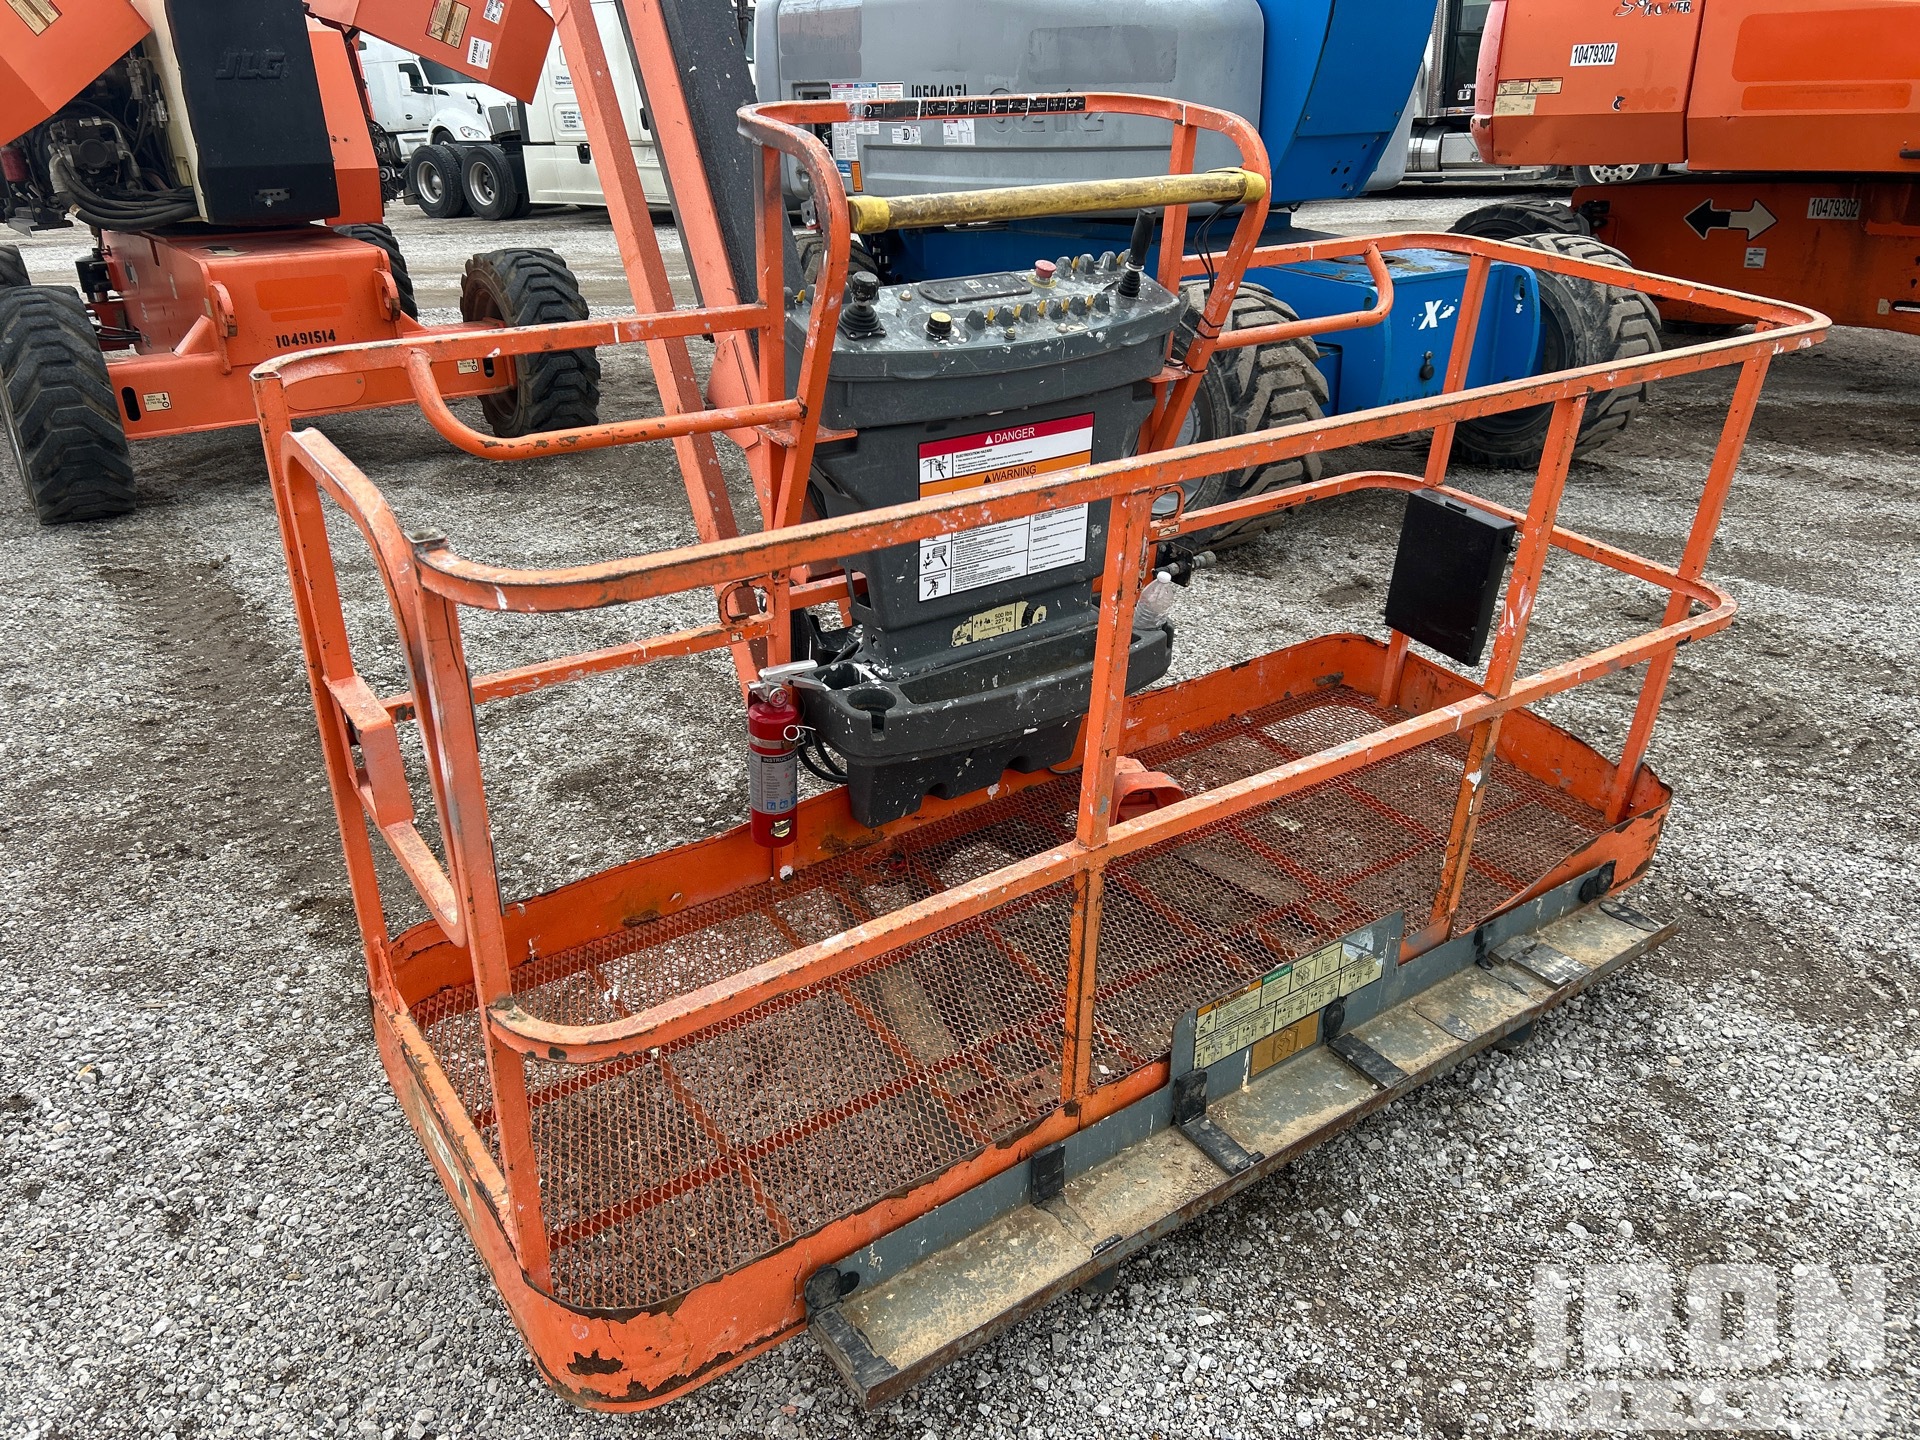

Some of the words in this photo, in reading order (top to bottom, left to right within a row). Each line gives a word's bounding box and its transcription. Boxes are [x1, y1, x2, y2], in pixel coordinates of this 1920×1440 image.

[1573, 43, 1616, 64] 10479302
[216, 52, 285, 80] JLG
[1811, 198, 1859, 218] 10479302
[275, 328, 336, 349] 10491514
[994, 426, 1036, 444] DANGER
[992, 464, 1037, 483] WARNING
